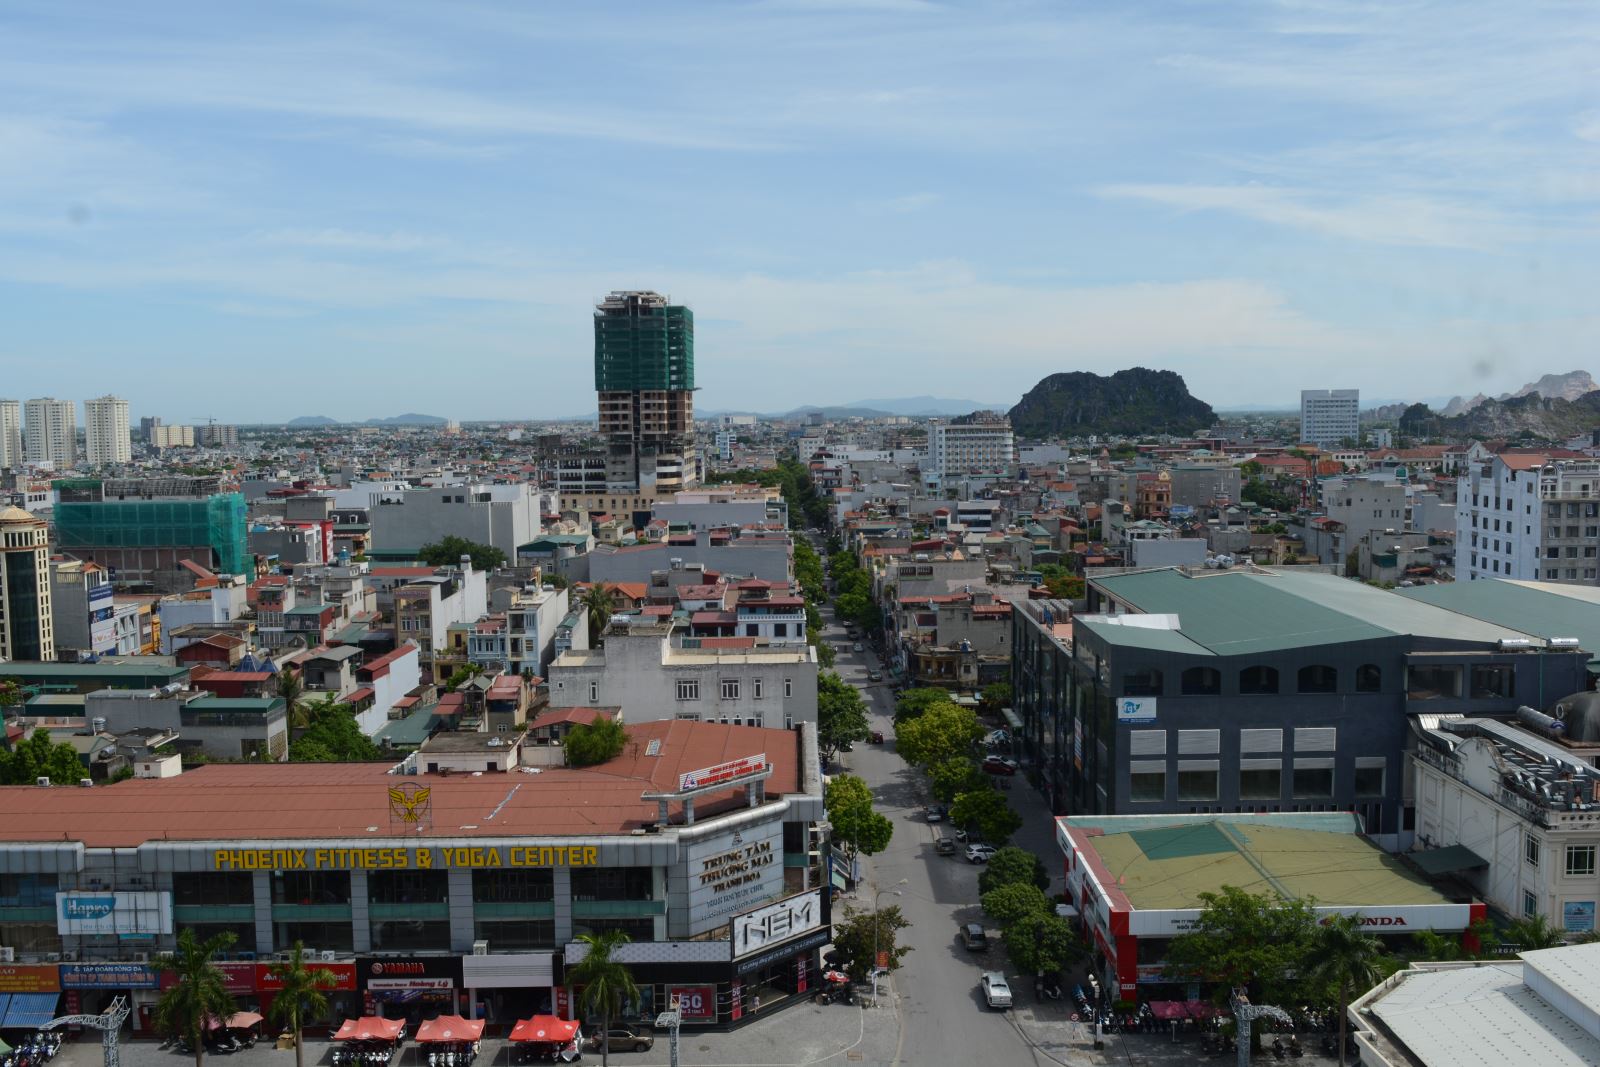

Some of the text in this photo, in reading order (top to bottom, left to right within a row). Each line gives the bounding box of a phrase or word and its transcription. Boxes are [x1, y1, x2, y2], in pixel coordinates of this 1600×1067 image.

[215, 846, 598, 869] PHOENIX FITNESS & YOGA CENTER
[703, 841, 771, 871] TRUNG TÂM
[700, 861, 749, 885] THƯƠNG
[67, 899, 110, 918] Hapro
[742, 902, 812, 945] NEM
[1345, 916, 1408, 926] ONDA
[383, 962, 424, 974] YAMAHA
[732, 987, 741, 997] 50
[680, 995, 703, 1009] 50
